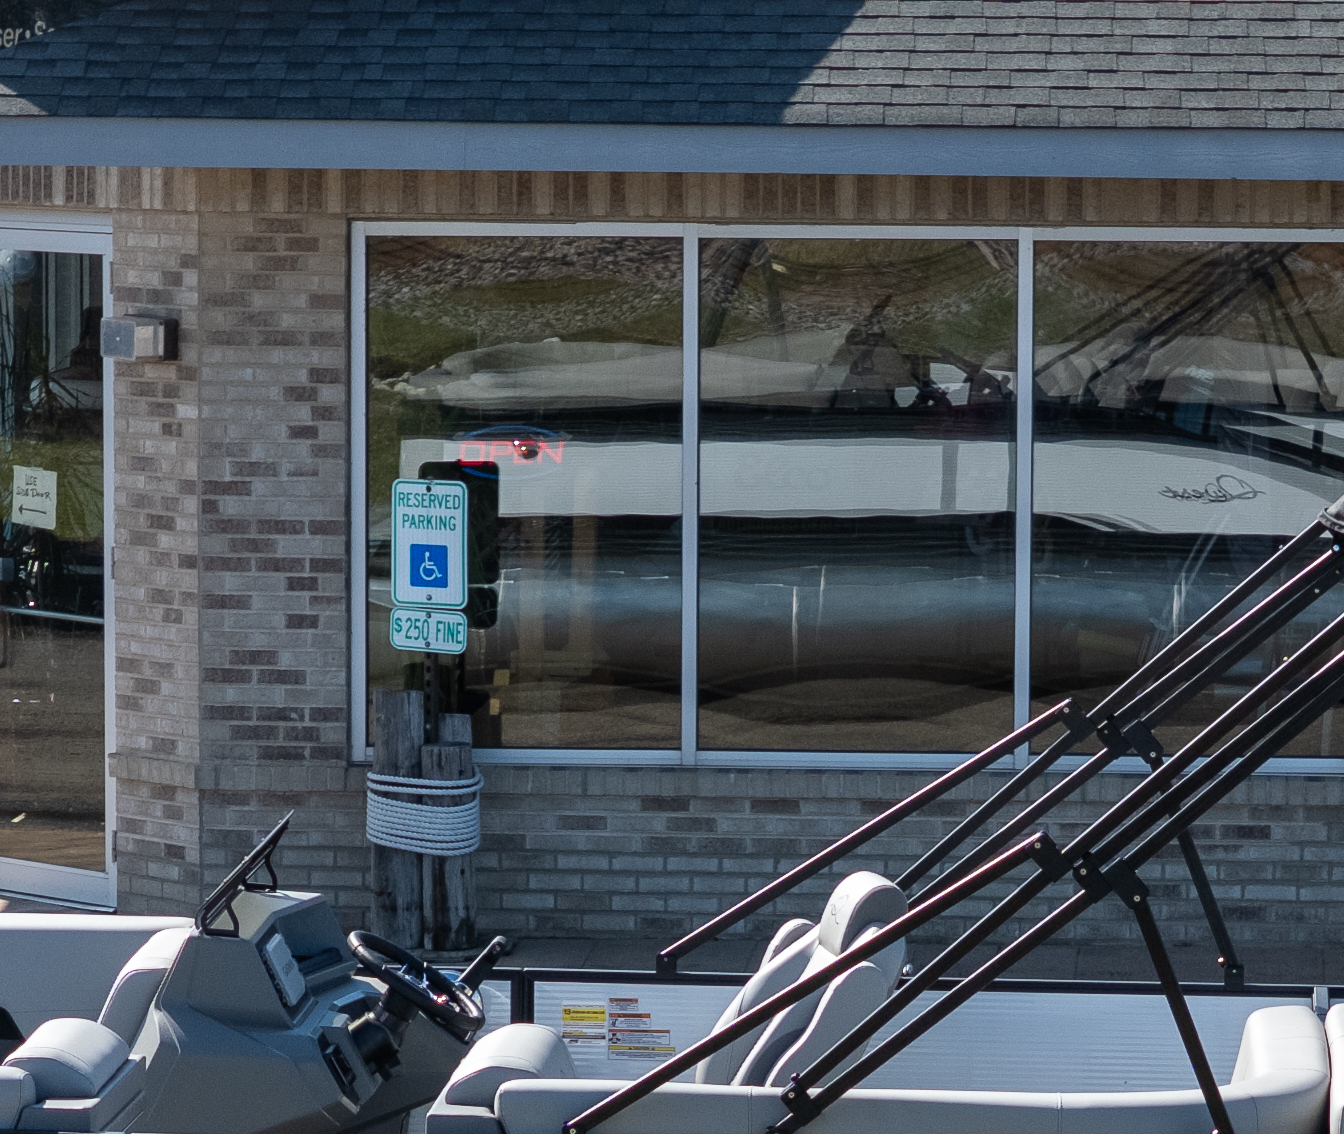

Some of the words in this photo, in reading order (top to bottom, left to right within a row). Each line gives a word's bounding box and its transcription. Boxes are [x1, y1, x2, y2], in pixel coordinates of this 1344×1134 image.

[459, 439, 565, 466] OPEN
[397, 492, 461, 510] RESERVED
[402, 513, 456, 532] PARKING
[436, 620, 463, 645] FINE
